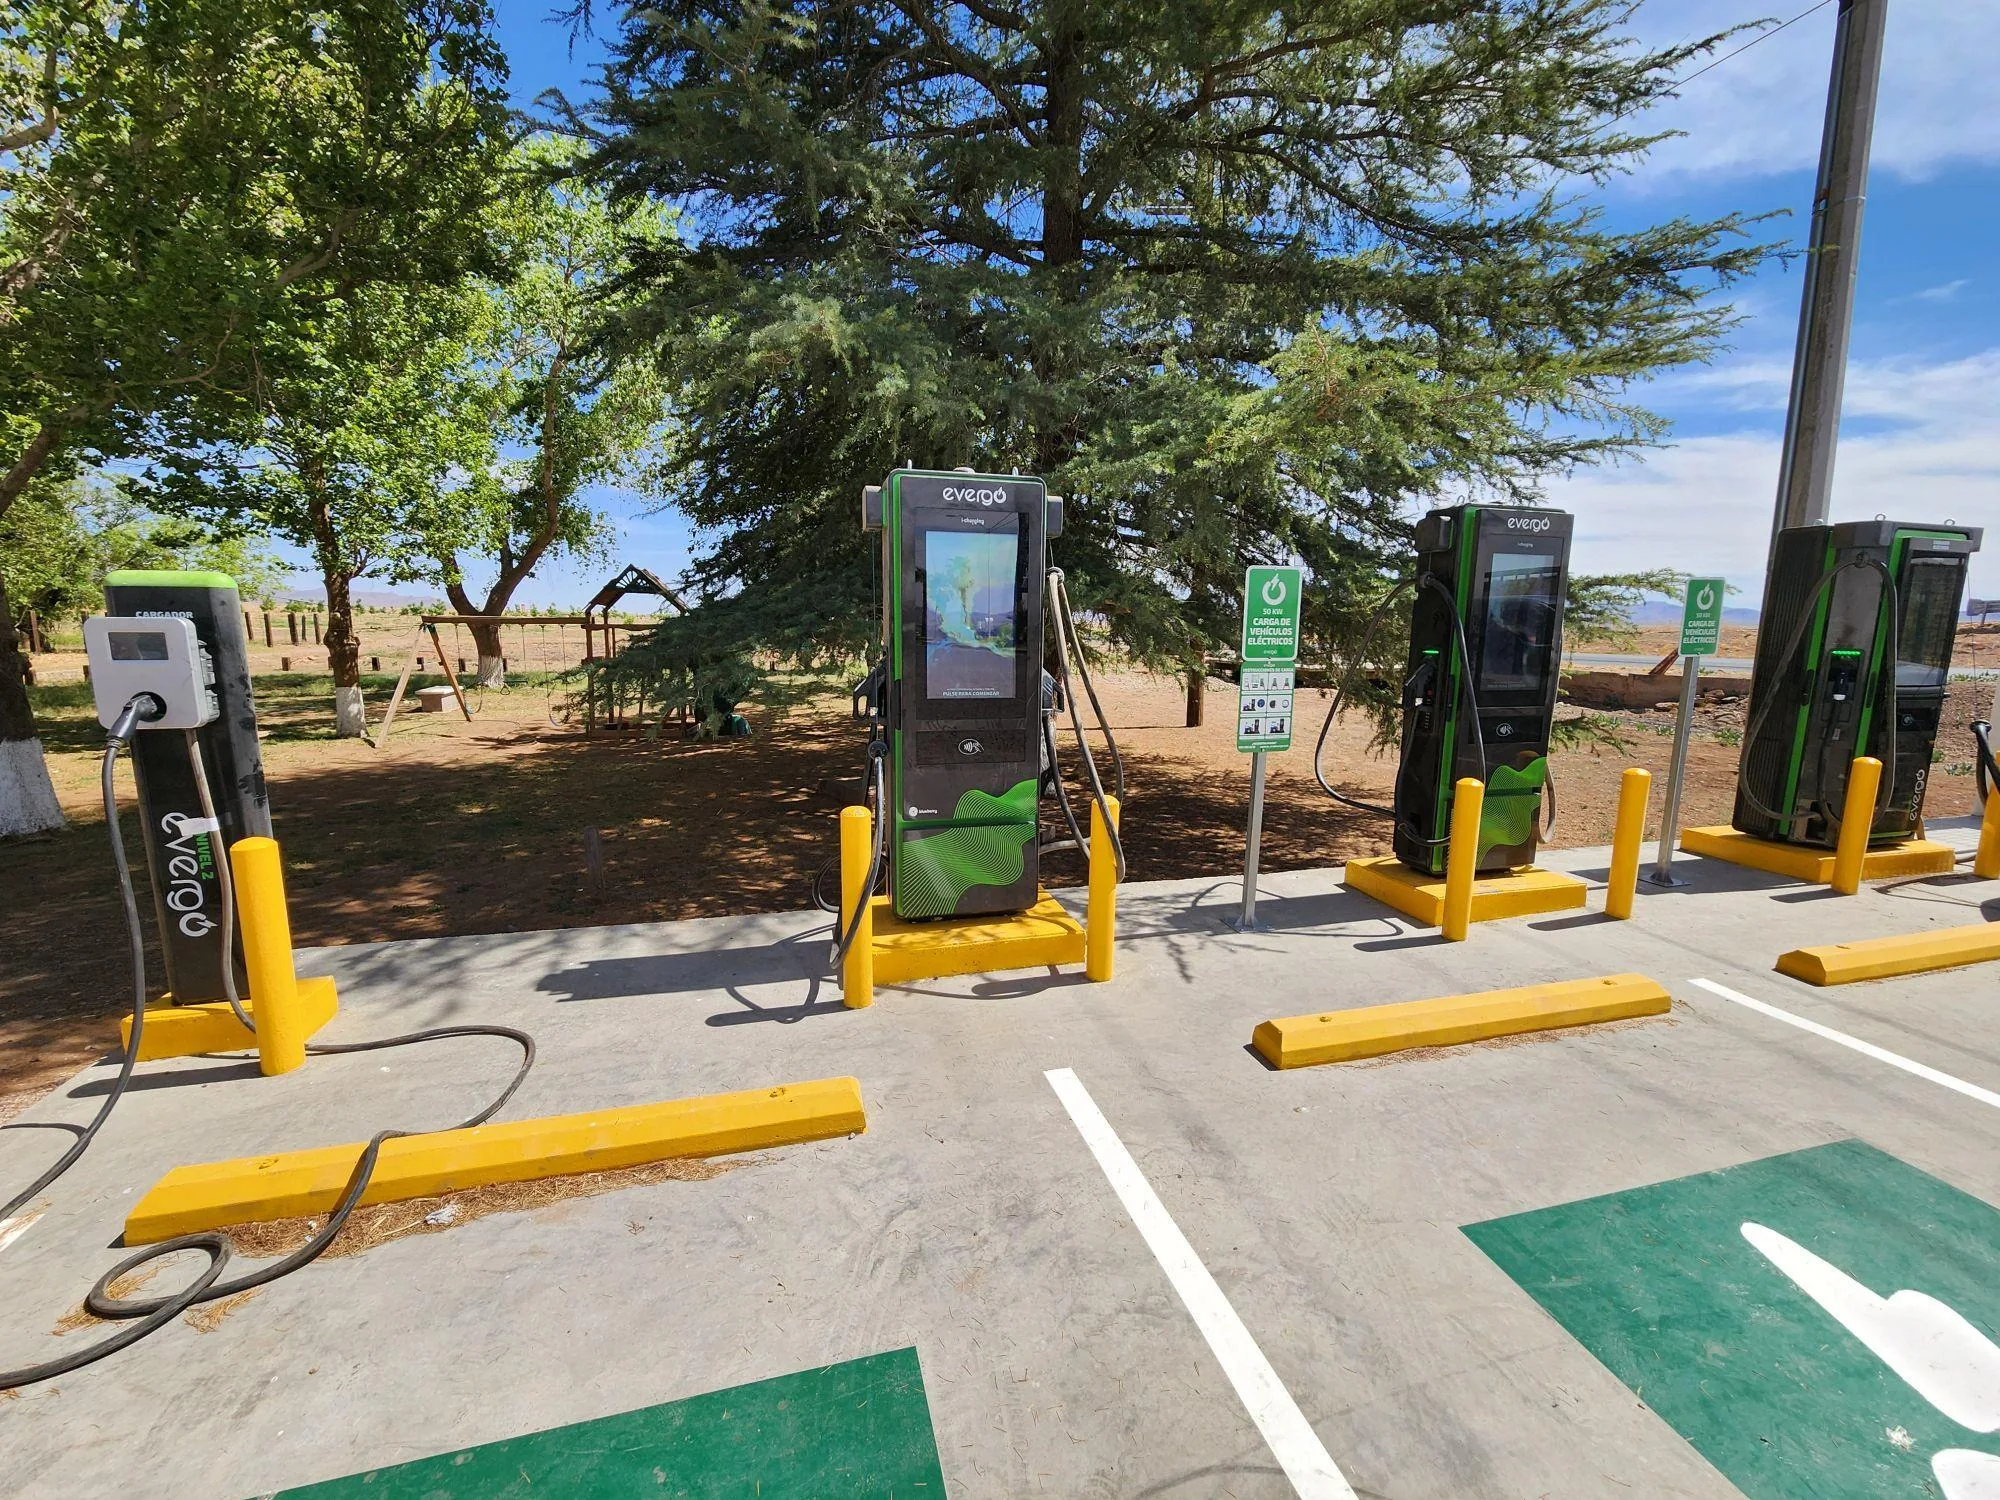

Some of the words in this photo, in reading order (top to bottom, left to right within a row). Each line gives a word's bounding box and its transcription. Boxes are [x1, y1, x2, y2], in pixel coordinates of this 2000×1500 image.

[943, 486, 1007, 506] evergo
[1507, 516, 1550, 533] evergo
[135, 611, 194, 619] CARGADOR
[1252, 617, 1279, 626] CARGA
[1280, 617, 1291, 626] DE
[1250, 626, 1293, 635] VEHÍCULOS
[1247, 636, 1294, 646] ELÉCTRICOS
[1909, 769, 1926, 821] evergo
[195, 832, 213, 869] NIVEL
[161, 812, 218, 937] evergo
[201, 871, 214, 880] 2
